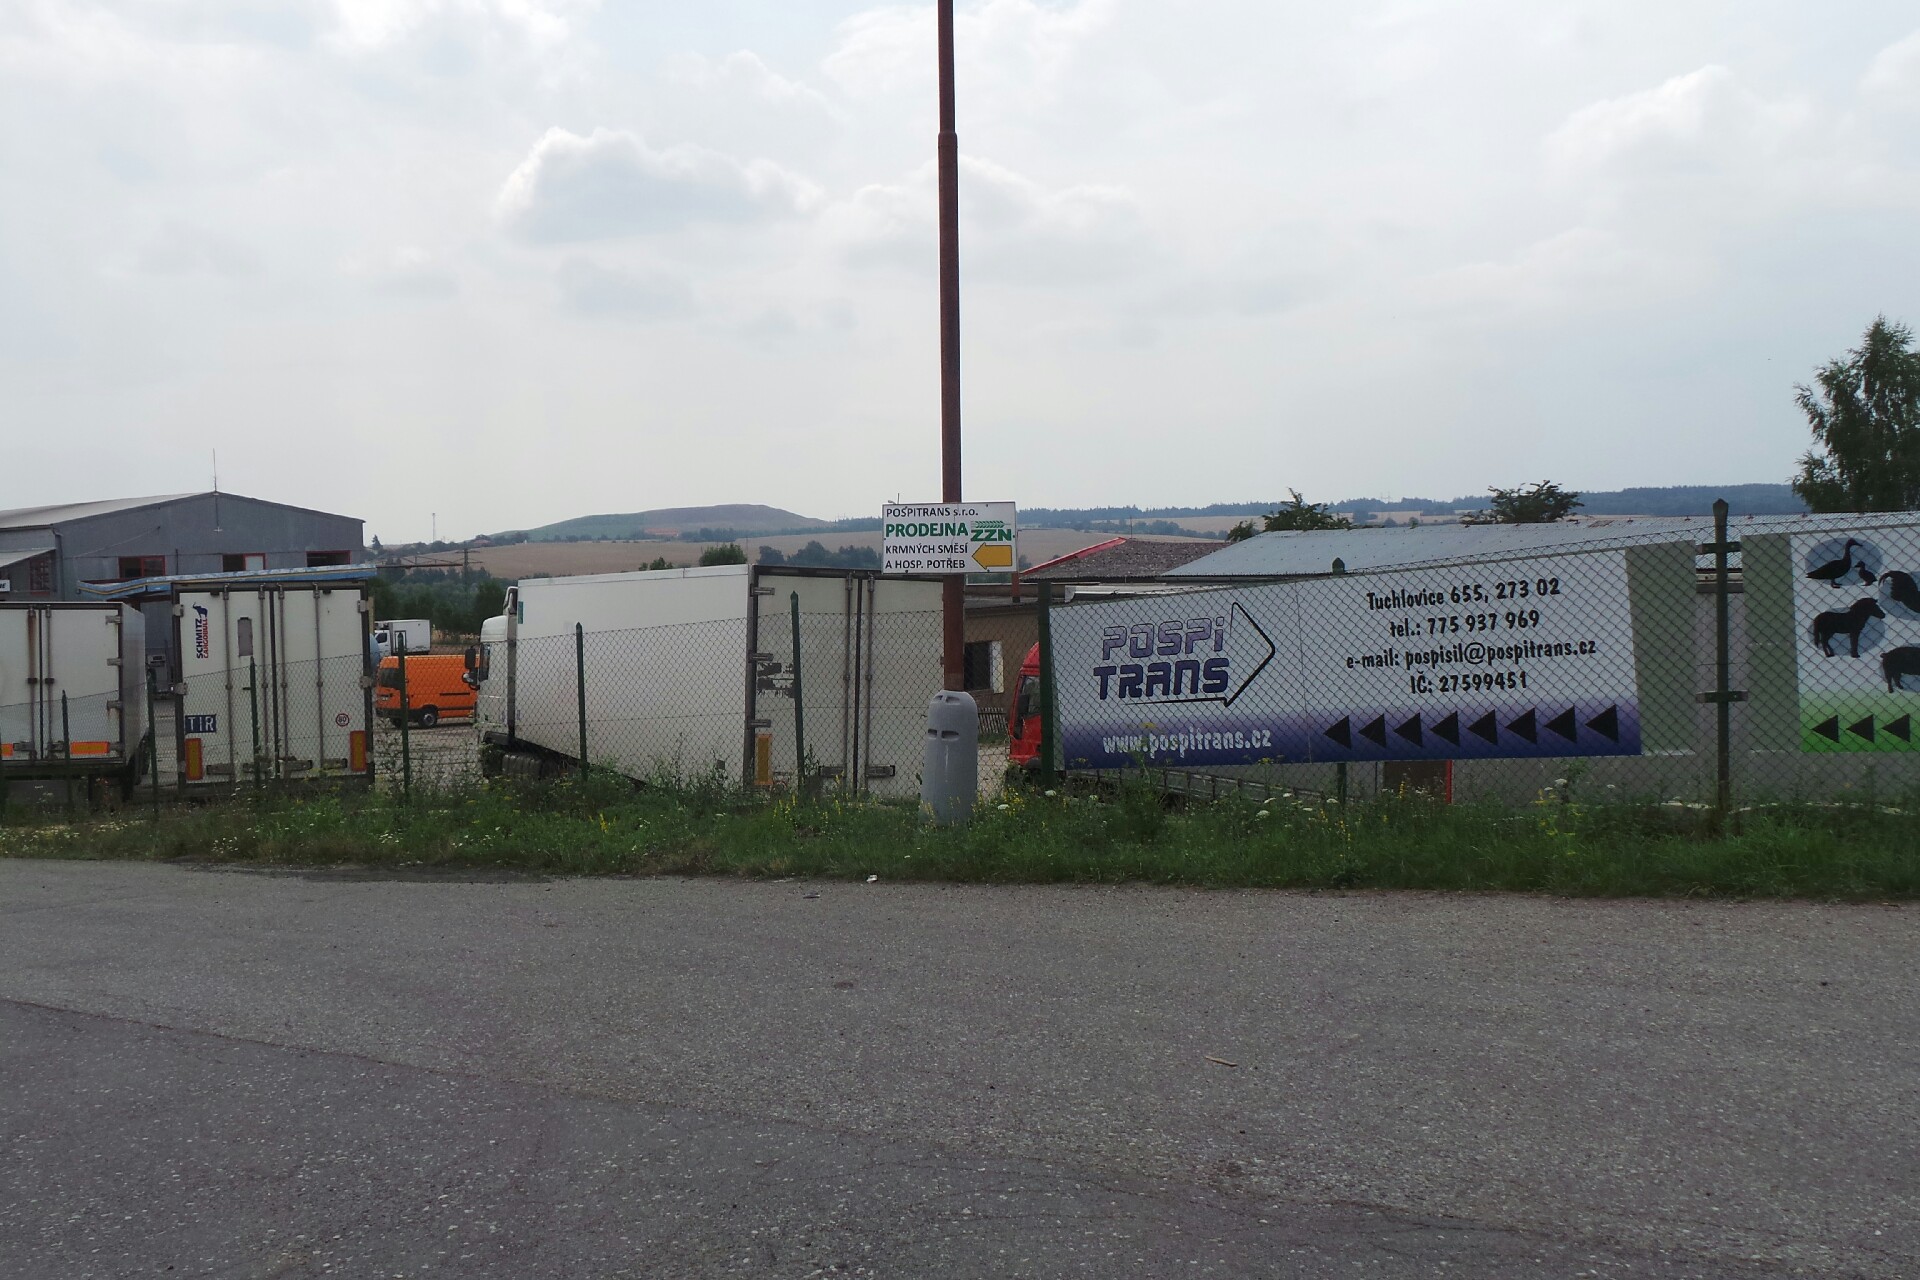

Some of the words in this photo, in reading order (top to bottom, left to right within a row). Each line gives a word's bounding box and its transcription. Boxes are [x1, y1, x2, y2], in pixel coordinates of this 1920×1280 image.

[953, 508, 979, 517] s.r.o.
[885, 522, 969, 538] PRODEJNA
[970, 529, 1012, 542] ZZN
[885, 543, 935, 554] KRMNÝCH
[937, 542, 968, 554] SMĚSÍ
[885, 560, 892, 569] A
[895, 559, 924, 569] HOSP.
[927, 557, 966, 569] POTŘEB
[1366, 588, 1444, 611] Tuchlovice
[1450, 584, 1489, 604] 655,
[1496, 579, 1530, 599] 273
[1536, 577, 1561, 596] 02
[1390, 620, 1421, 638] tel.:
[1428, 616, 1459, 635] 775
[1465, 613, 1497, 633] 937
[1505, 609, 1540, 629] 969
[195, 618, 204, 659] SCHMITZ
[1346, 648, 1400, 670] e-mail:
[1405, 640, 1597, 670] pospisil@pospitrans.cz
[1093, 657, 1230, 700] TRANS
[1410, 671, 1433, 695] IČ:
[1438, 671, 1527, 693] 27599451
[188, 716, 214, 732] TIR
[1102, 726, 1272, 759] www.pospitrans.cz
